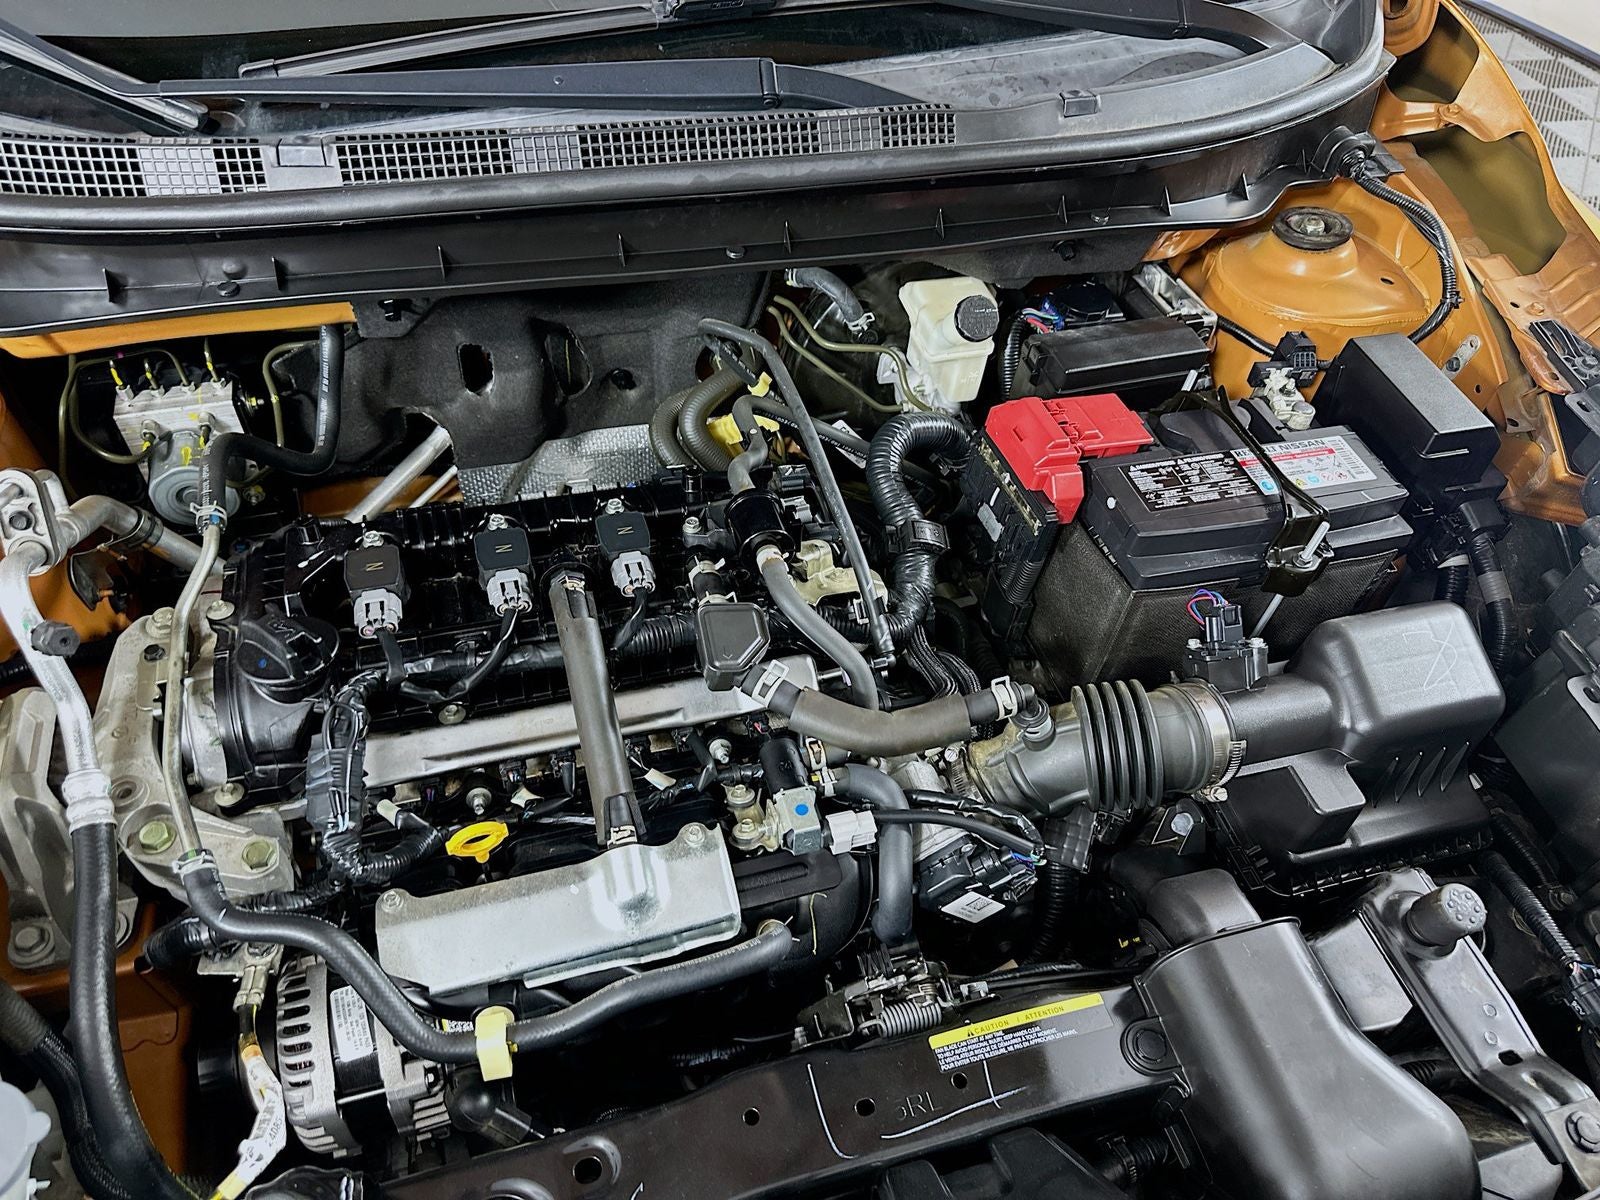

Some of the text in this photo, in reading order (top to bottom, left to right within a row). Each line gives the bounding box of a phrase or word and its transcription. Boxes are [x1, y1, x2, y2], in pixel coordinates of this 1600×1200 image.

[1280, 440, 1326, 452] NISSAN
[974, 1020, 1009, 1034] CAUTION
[1024, 1005, 1064, 1020] ATTENTION
[940, 1062, 955, 1071] POUR
[969, 1054, 985, 1063] TOUTE
[1029, 1034, 1056, 1046] APPROCHER
[943, 1043, 958, 1051] BLADE
[966, 1037, 979, 1045] START
[944, 1050, 975, 1063] VENTILATEUR
[974, 1046, 991, 1055] RISQUE
[1025, 1033, 1038, 1041] TOUT
[954, 1046, 968, 1054] AVOID
[968, 1040, 989, 1051] PERSONAL
[1013, 1030, 1028, 1038] HANDS
